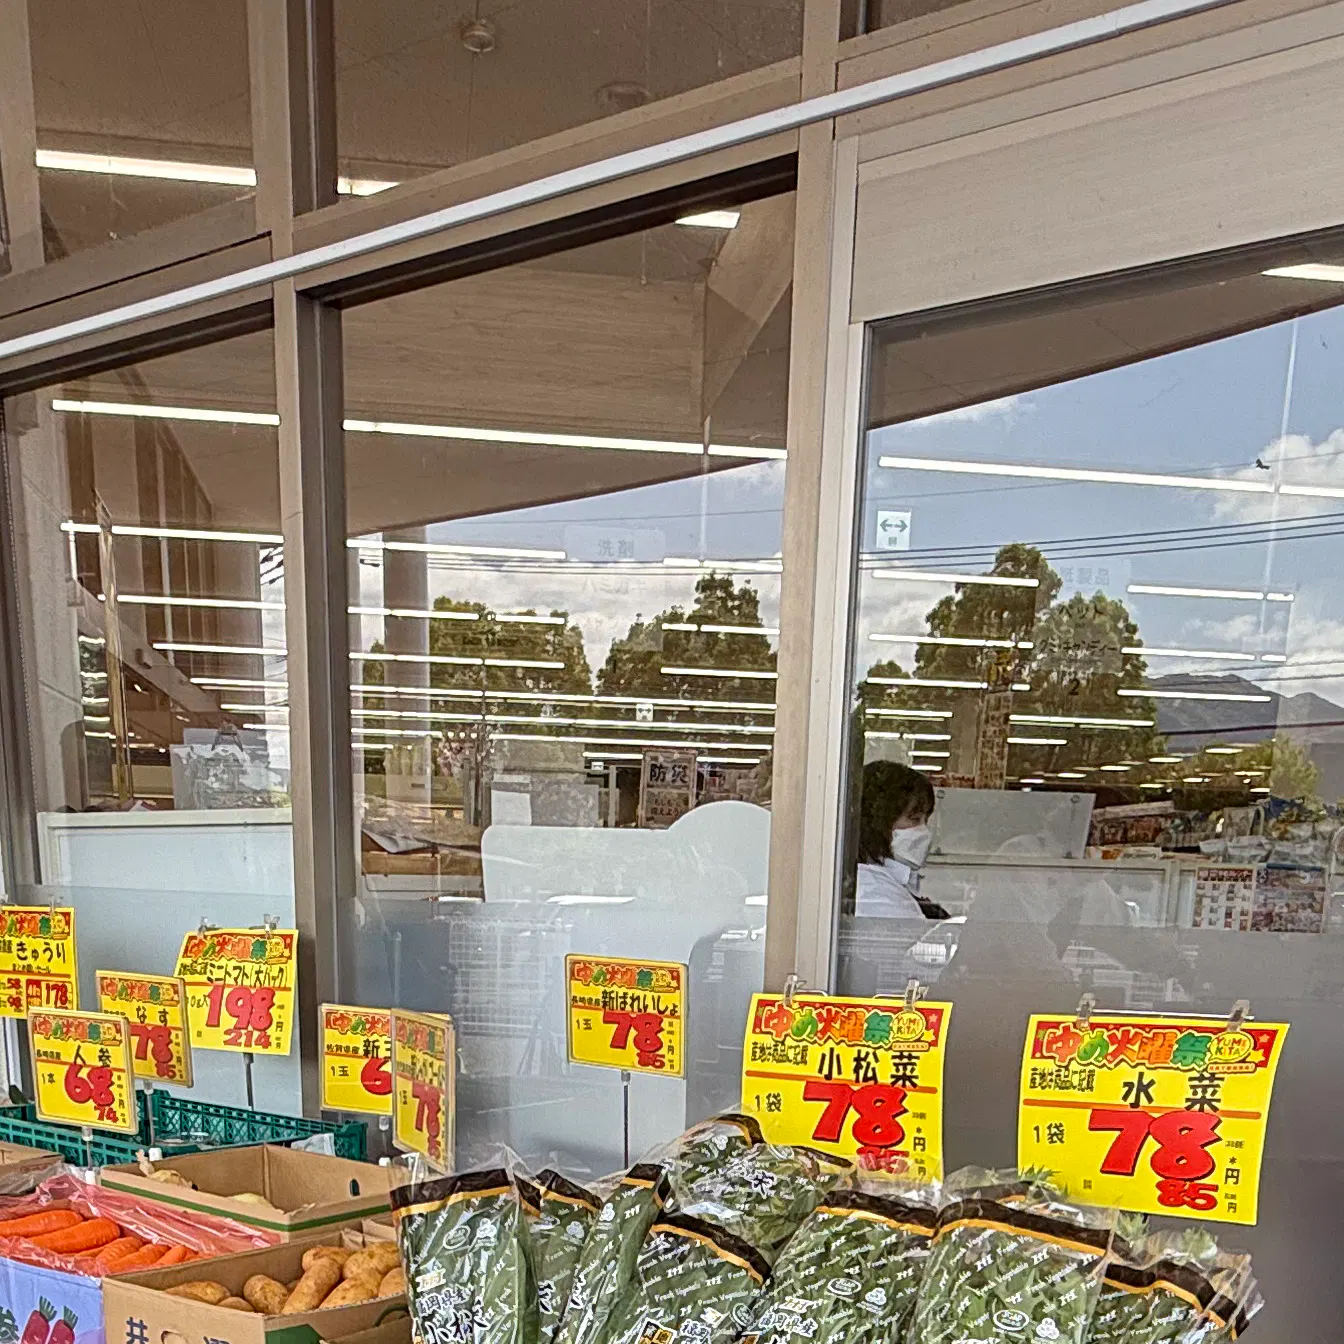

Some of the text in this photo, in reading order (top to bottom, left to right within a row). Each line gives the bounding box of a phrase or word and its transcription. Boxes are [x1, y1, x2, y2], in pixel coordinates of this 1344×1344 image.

[650, 763, 689, 784] 防災
[16, 940, 67, 965] きゅうり
[135, 1005, 170, 1027] なす
[205, 984, 276, 1031] 198
[222, 1028, 272, 1049] 214
[602, 1011, 665, 1053] 78
[761, 1001, 896, 1050] ゆめ火曜祭
[73, 1044, 113, 1068] 人参
[130, 1021, 174, 1064] 78
[1044, 1023, 1214, 1071] ゆめ火曜祭
[64, 1061, 116, 1107] 68
[330, 1065, 350, 1077] 1玉
[817, 1047, 921, 1090] 小松菜
[754, 1092, 782, 1113] 1袋
[1121, 1072, 1225, 1112] 水菜
[93, 1104, 120, 1123] 74
[412, 1082, 442, 1139] 78
[803, 1081, 910, 1149] 78
[912, 1136, 926, 1152] 円
[1033, 1122, 1066, 1145] 1袋
[1088, 1109, 1223, 1181] 78
[1223, 1168, 1241, 1185] 円
[1155, 1179, 1220, 1211] 85
